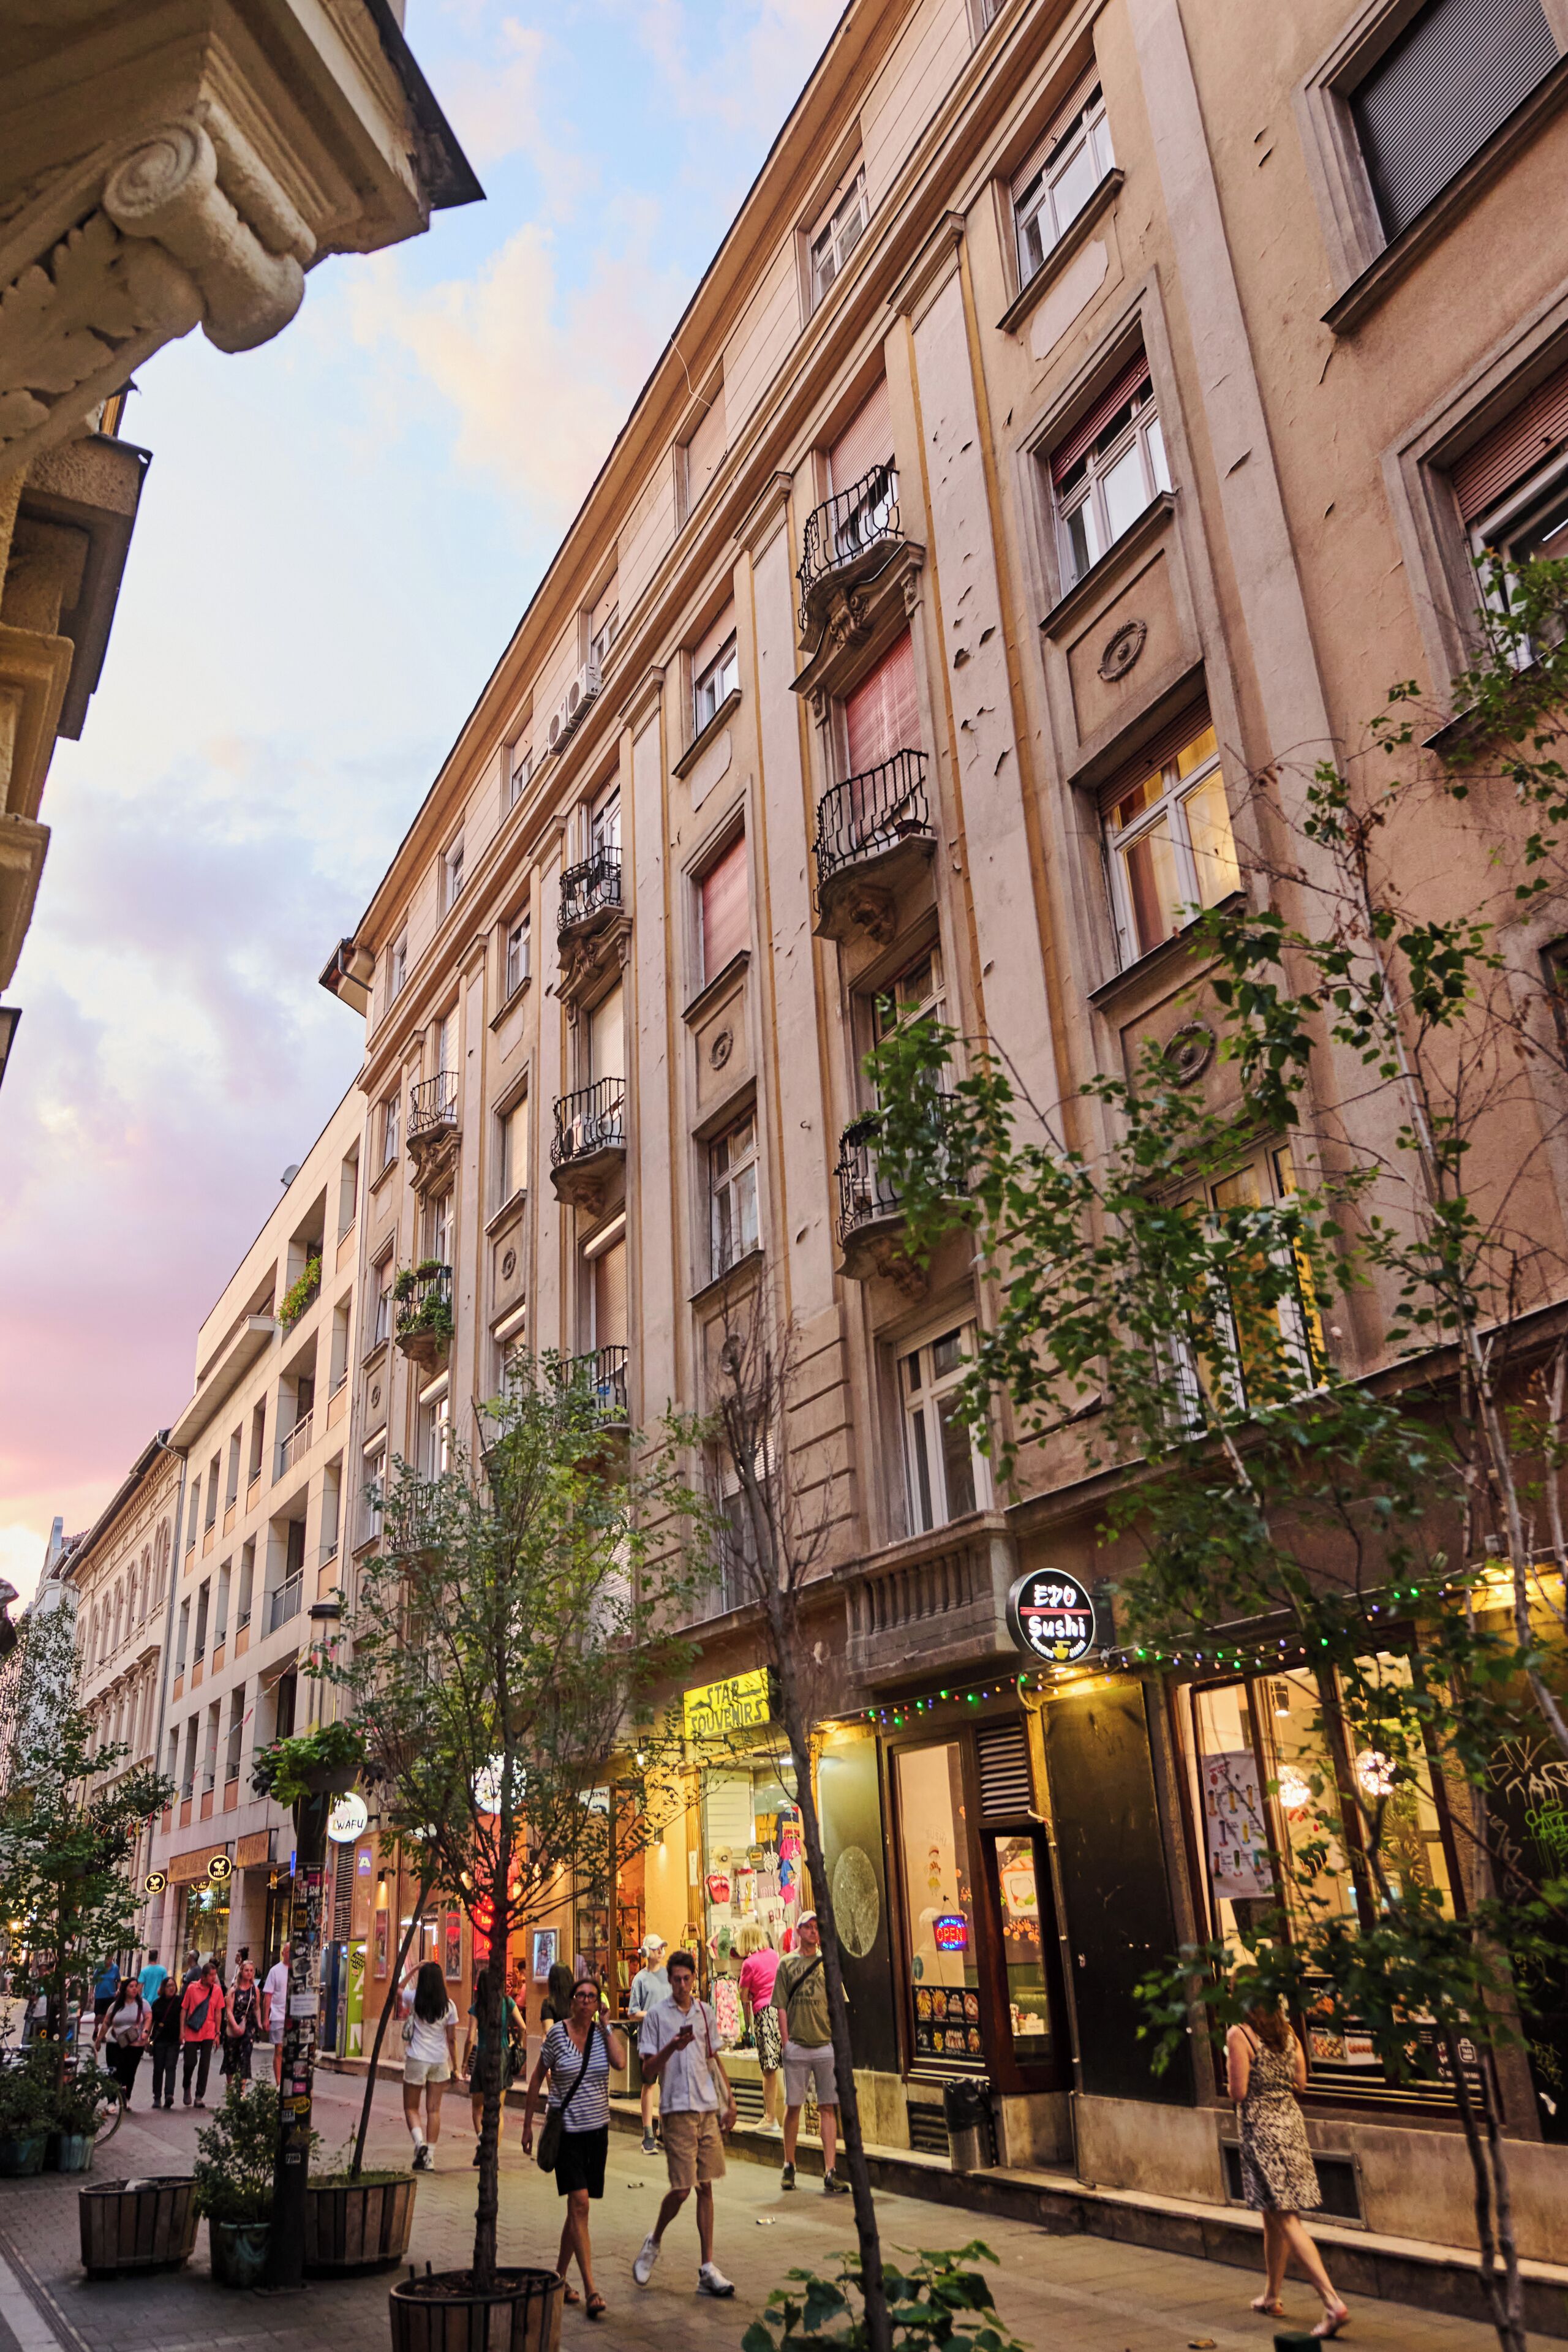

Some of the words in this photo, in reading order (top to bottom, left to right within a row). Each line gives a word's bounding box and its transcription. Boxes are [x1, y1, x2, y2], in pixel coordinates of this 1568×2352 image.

[1028, 1613, 1085, 1638] Sushi
[707, 1680, 739, 1705] STAR
[692, 1700, 762, 1734] SOUVENIRS
[337, 1819, 364, 1830] WAFU
[937, 1927, 963, 1942] OPEN
